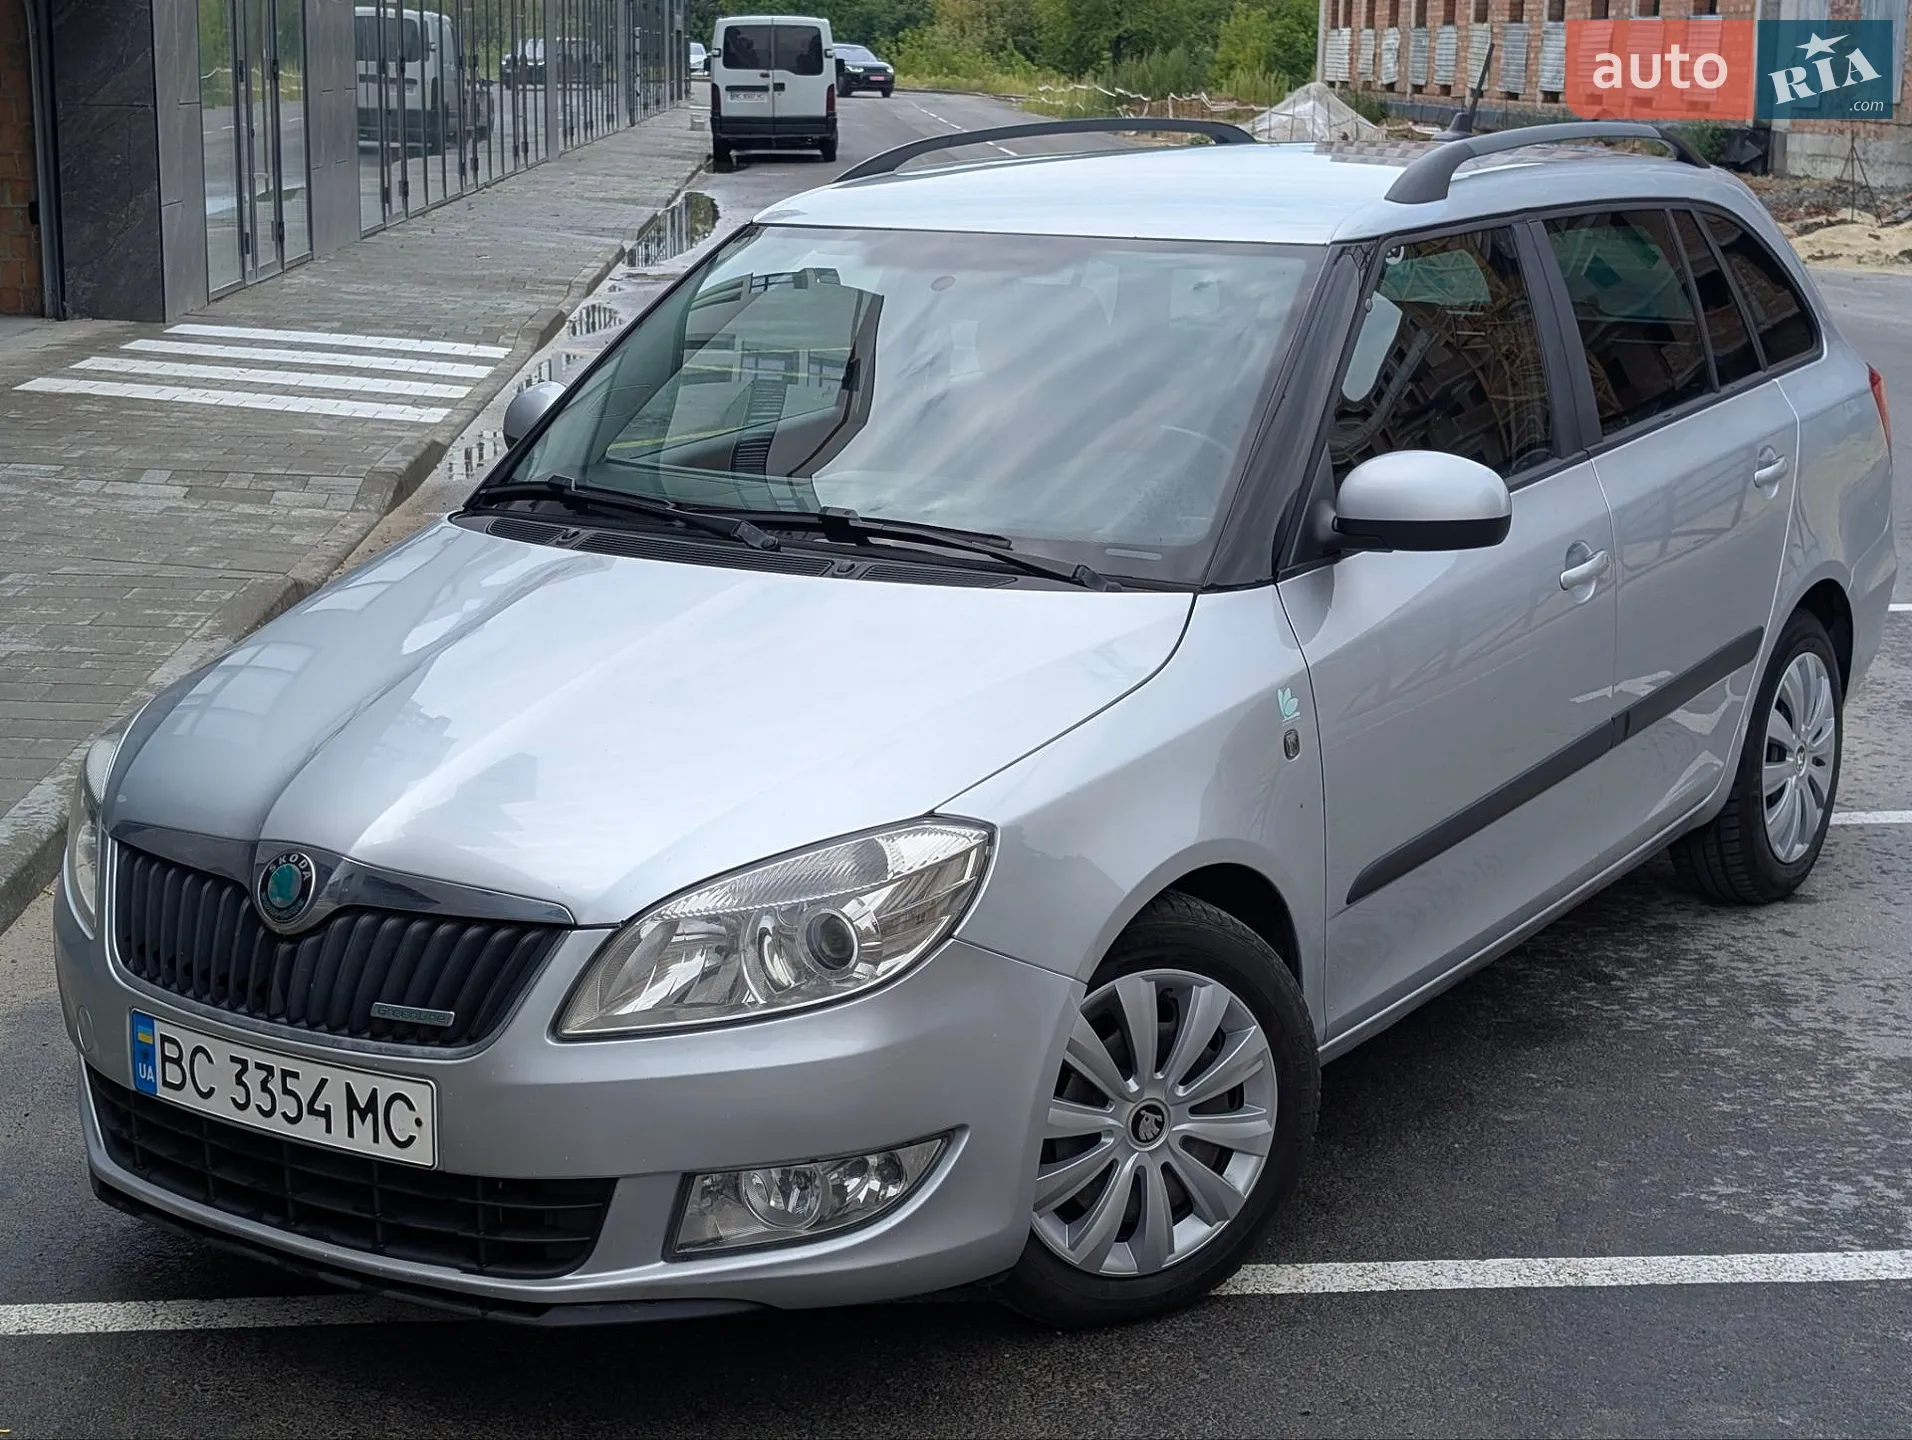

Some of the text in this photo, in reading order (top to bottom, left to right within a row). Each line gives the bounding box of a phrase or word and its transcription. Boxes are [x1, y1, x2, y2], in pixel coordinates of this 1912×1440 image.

[138, 1063, 155, 1083] UA
[159, 1032, 418, 1149] BC 3354 MC
